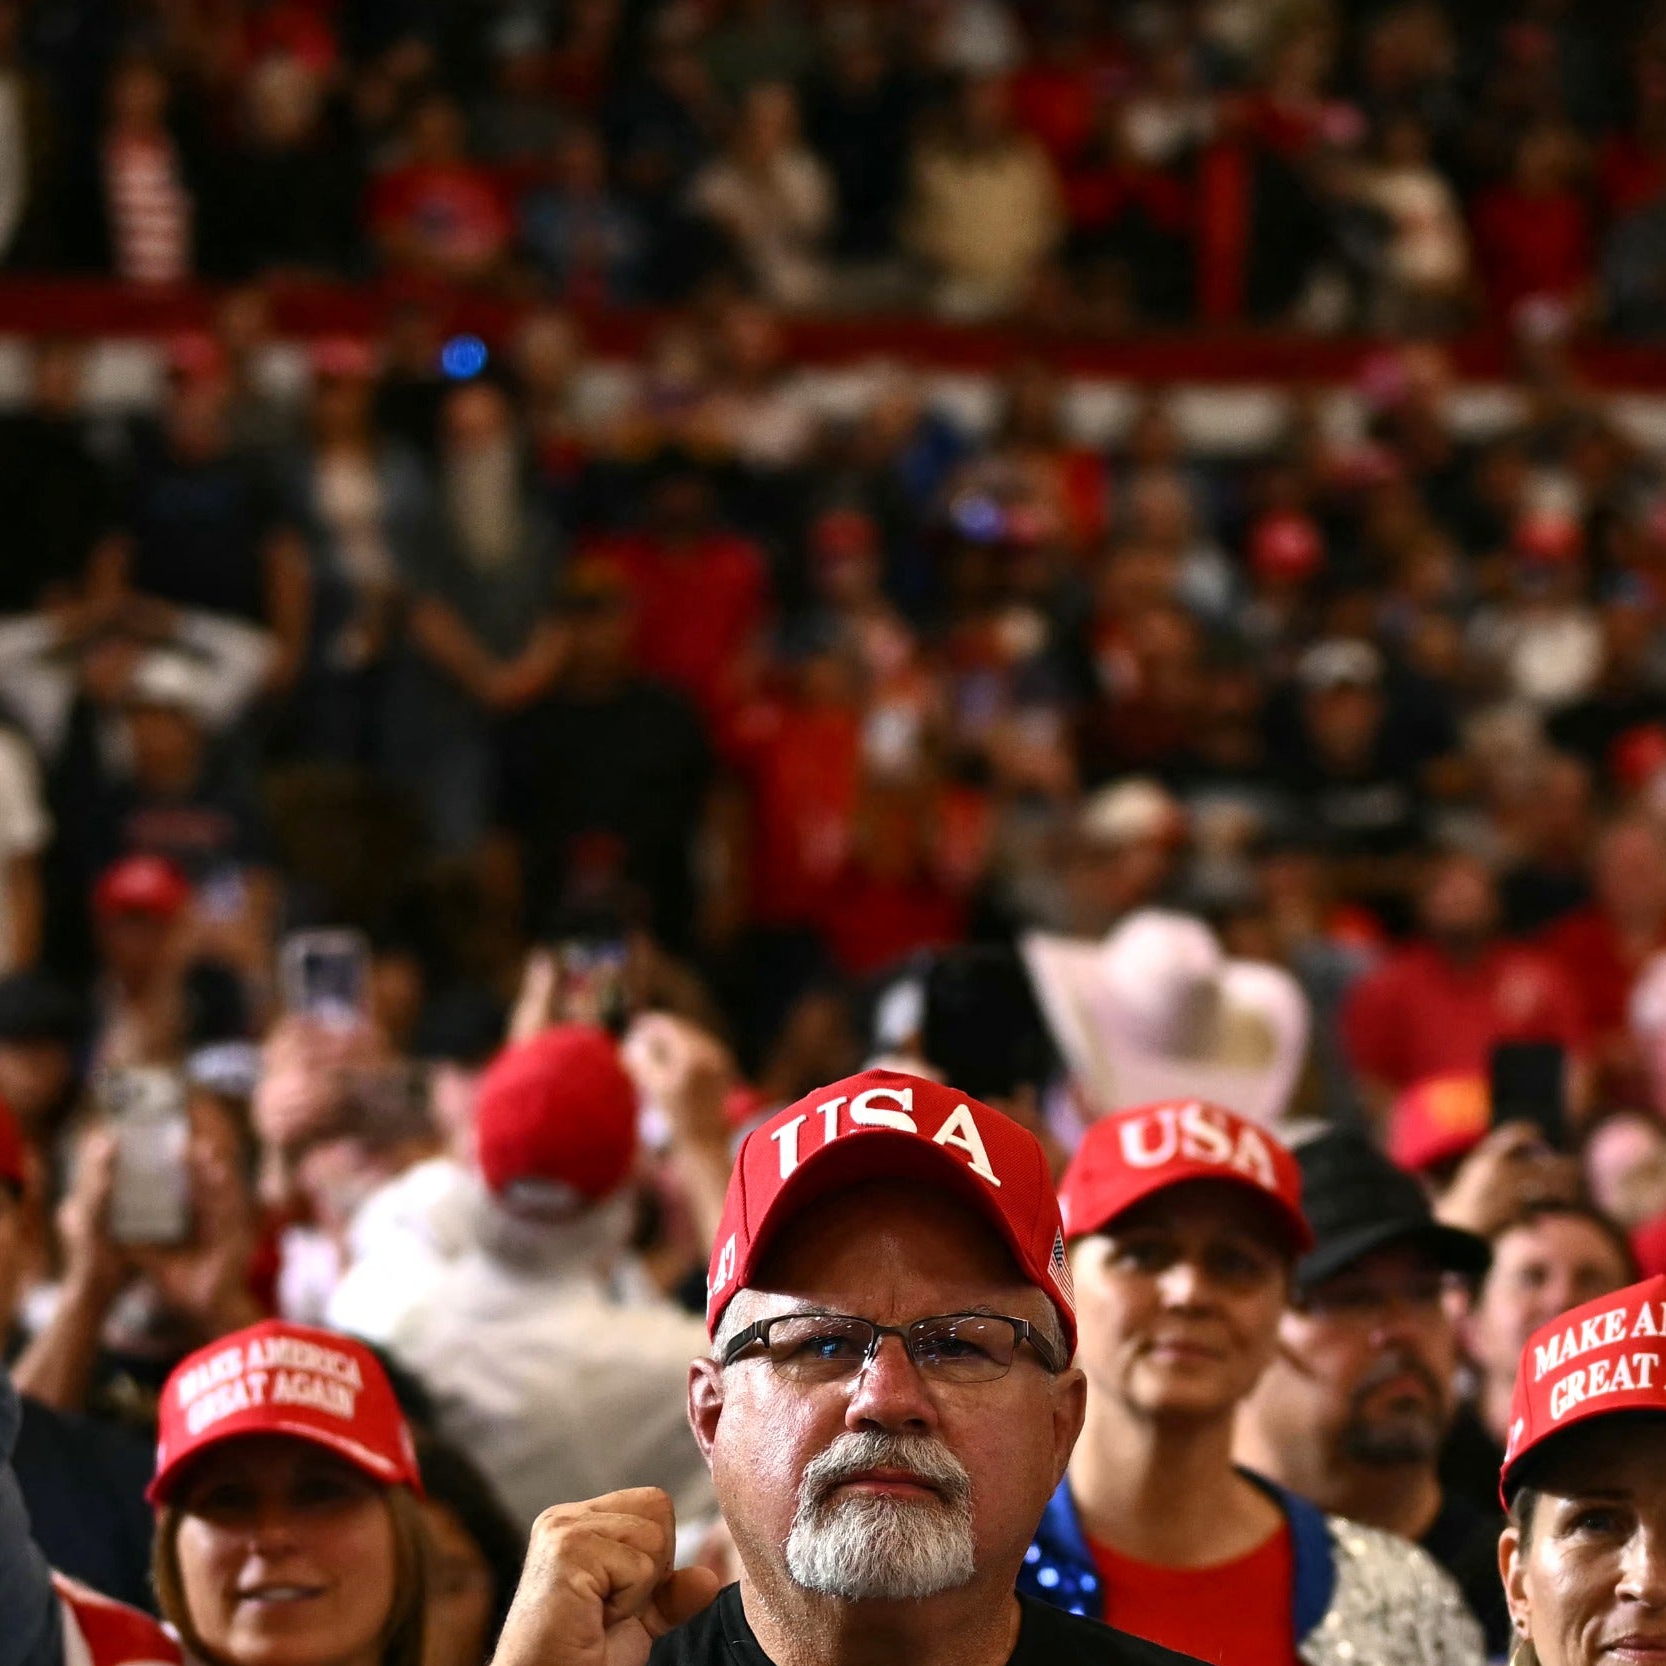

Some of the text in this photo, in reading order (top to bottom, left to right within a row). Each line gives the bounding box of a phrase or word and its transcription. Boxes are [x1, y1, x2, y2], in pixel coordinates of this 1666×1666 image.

[771, 1088, 1002, 1188] USA
[1119, 1102, 1278, 1191] USA
[176, 1336, 364, 1409] MAKE AMERICA
[1534, 1307, 1627, 1382] MAKE
[187, 1369, 356, 1436] GREAT AGAIN
[1549, 1352, 1660, 1421] GREAT
